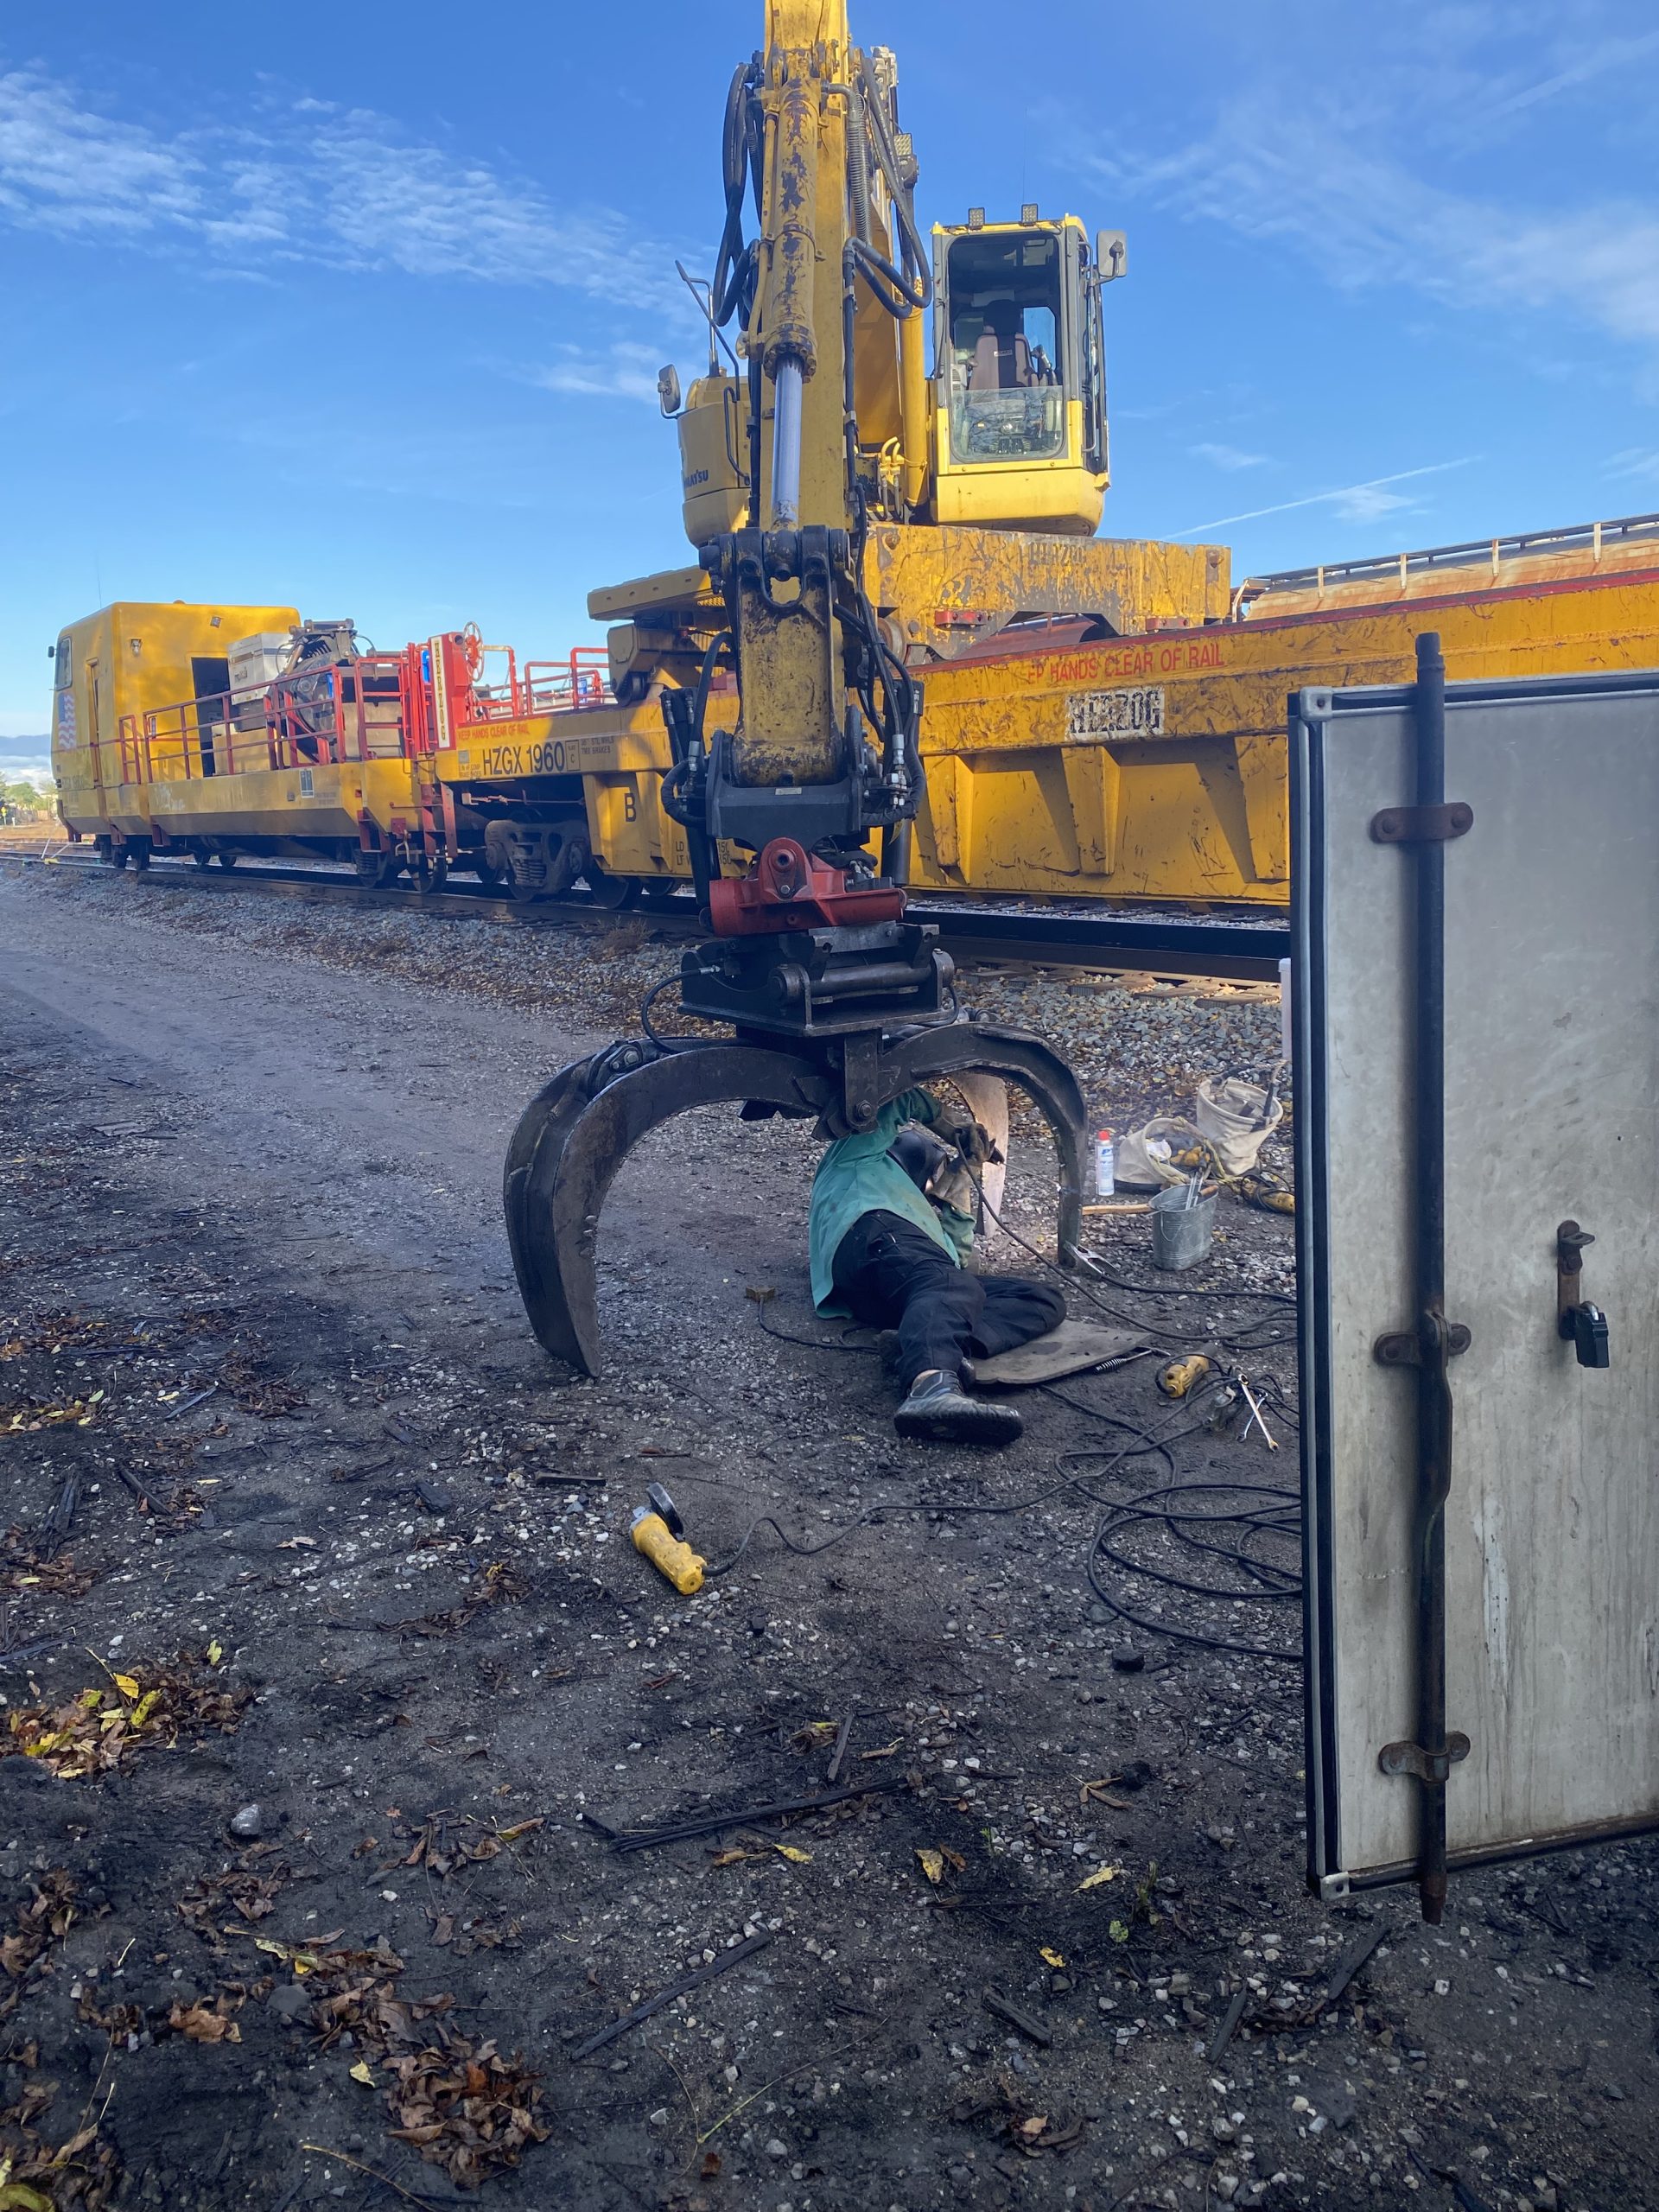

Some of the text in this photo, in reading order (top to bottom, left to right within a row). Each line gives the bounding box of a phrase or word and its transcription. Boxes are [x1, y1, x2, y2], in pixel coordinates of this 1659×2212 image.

[1050, 658, 1098, 682] HANDS
[1104, 651, 1154, 677] CLEAR
[1160, 648, 1183, 672] OF
[1189, 643, 1225, 668] RAIL
[435, 642, 446, 741] HERZOG
[482, 741, 565, 775] HZGX 1960
[624, 792, 637, 822] B
[676, 841, 684, 852] LD
[677, 855, 684, 866] LT
